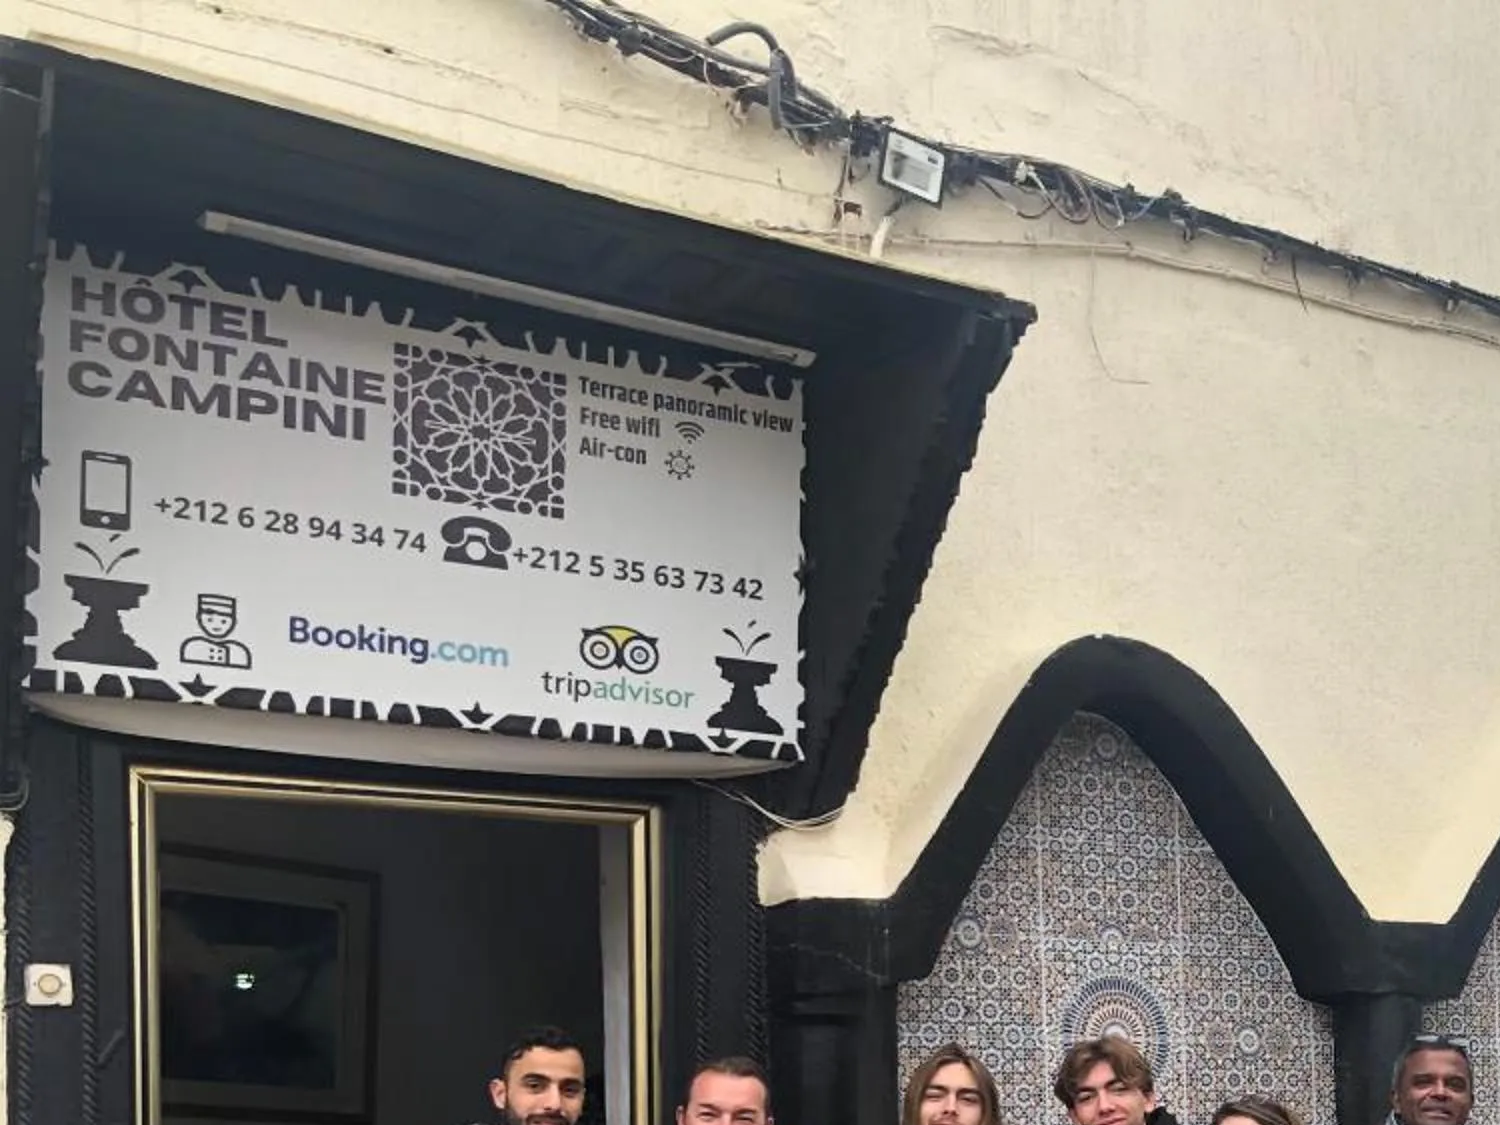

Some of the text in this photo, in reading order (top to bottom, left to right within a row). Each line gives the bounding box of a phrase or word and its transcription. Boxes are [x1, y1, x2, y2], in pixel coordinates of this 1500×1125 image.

[71, 276, 288, 348] HÔTEL
[70, 319, 387, 405] FONTAINE
[68, 360, 366, 441] CAMPINI
[578, 375, 794, 433] Terrace panoramic view
[579, 406, 661, 438] Free wifi
[579, 436, 648, 465] Air-con
[154, 497, 427, 553] +212 6 28 94 34 74
[512, 547, 765, 601] +212 5 35 63 73 42
[288, 615, 510, 667] Booking.com
[541, 671, 695, 709] tripadvisor
